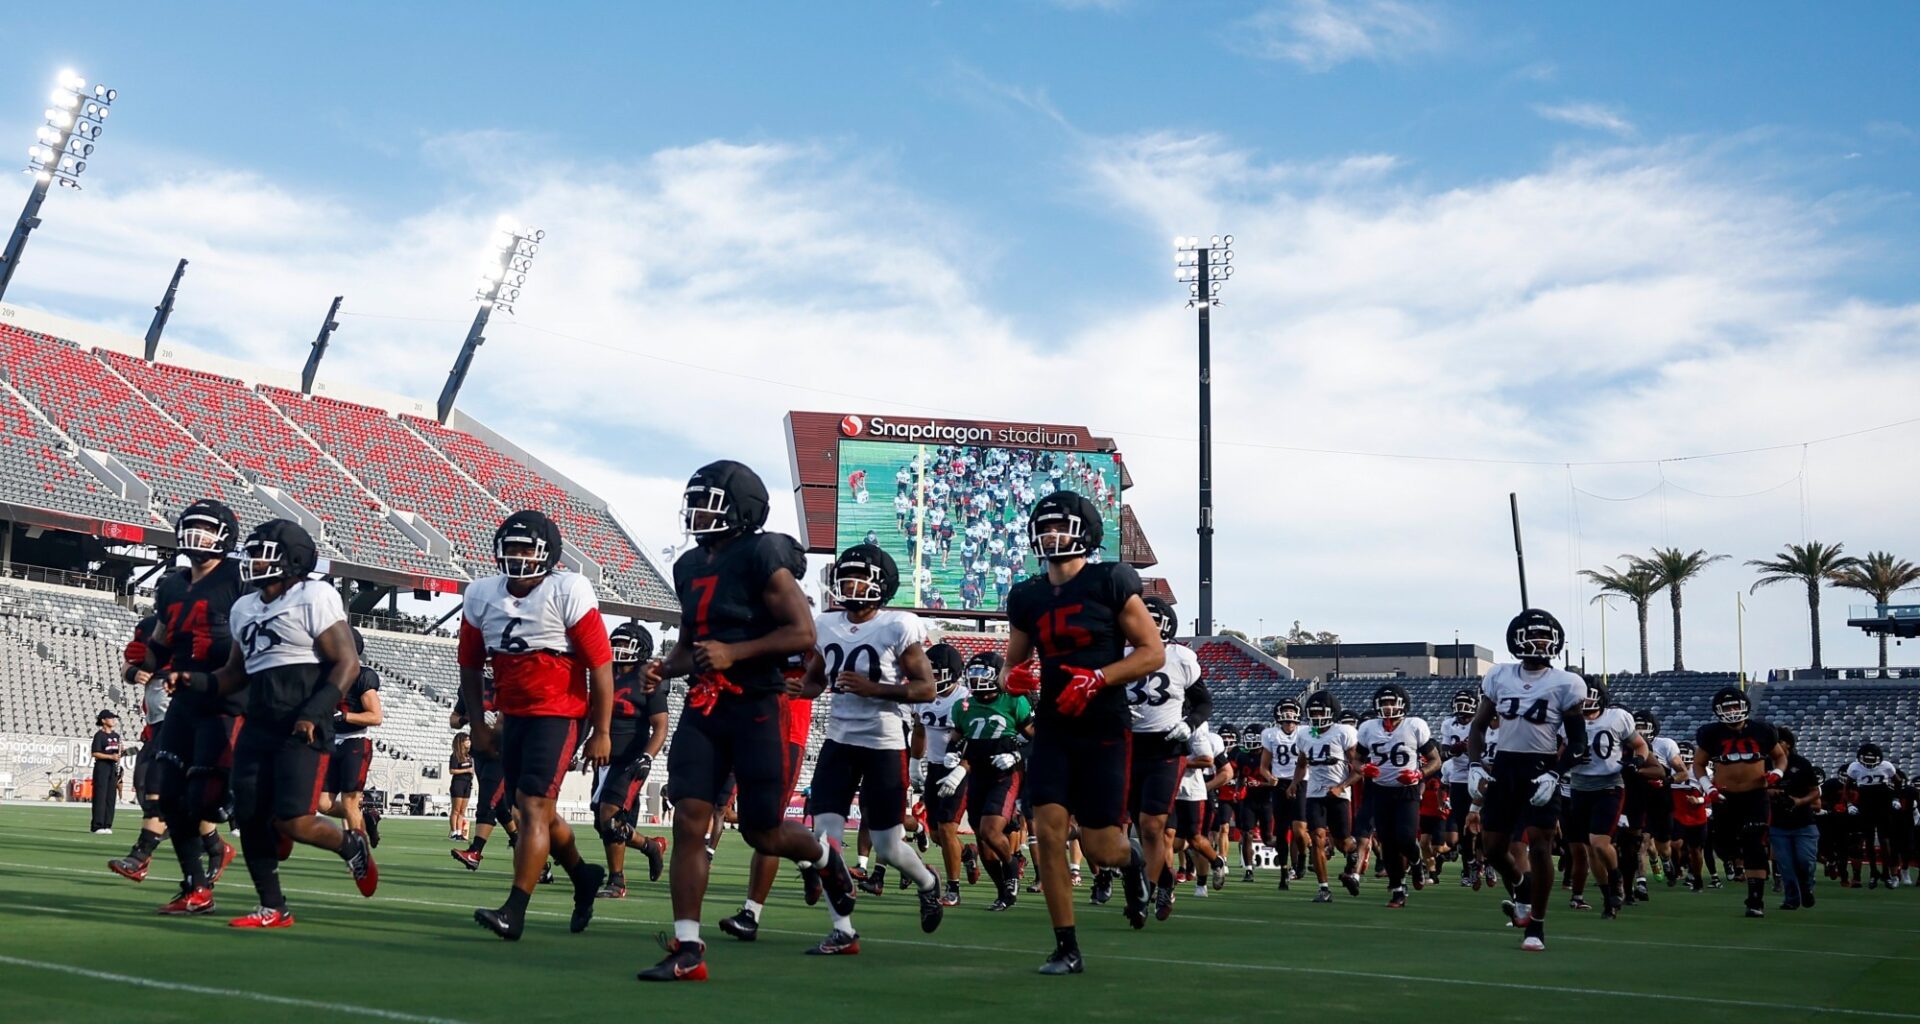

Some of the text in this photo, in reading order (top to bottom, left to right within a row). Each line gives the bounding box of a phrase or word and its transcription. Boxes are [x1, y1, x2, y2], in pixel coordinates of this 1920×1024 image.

[2, 307, 15, 318] 209
[162, 349, 173, 359] 210
[869, 417, 1078, 446] Snapdragon stadium
[691, 575, 719, 637] 7
[165, 599, 214, 662] 74
[241, 611, 289, 660] 95
[501, 617, 529, 653] 6
[1036, 603, 1093, 657] 15
[824, 642, 882, 695] 20
[1125, 671, 1171, 707] 33
[12, 753, 52, 765] stadium
[1371, 741, 1410, 767] 56
